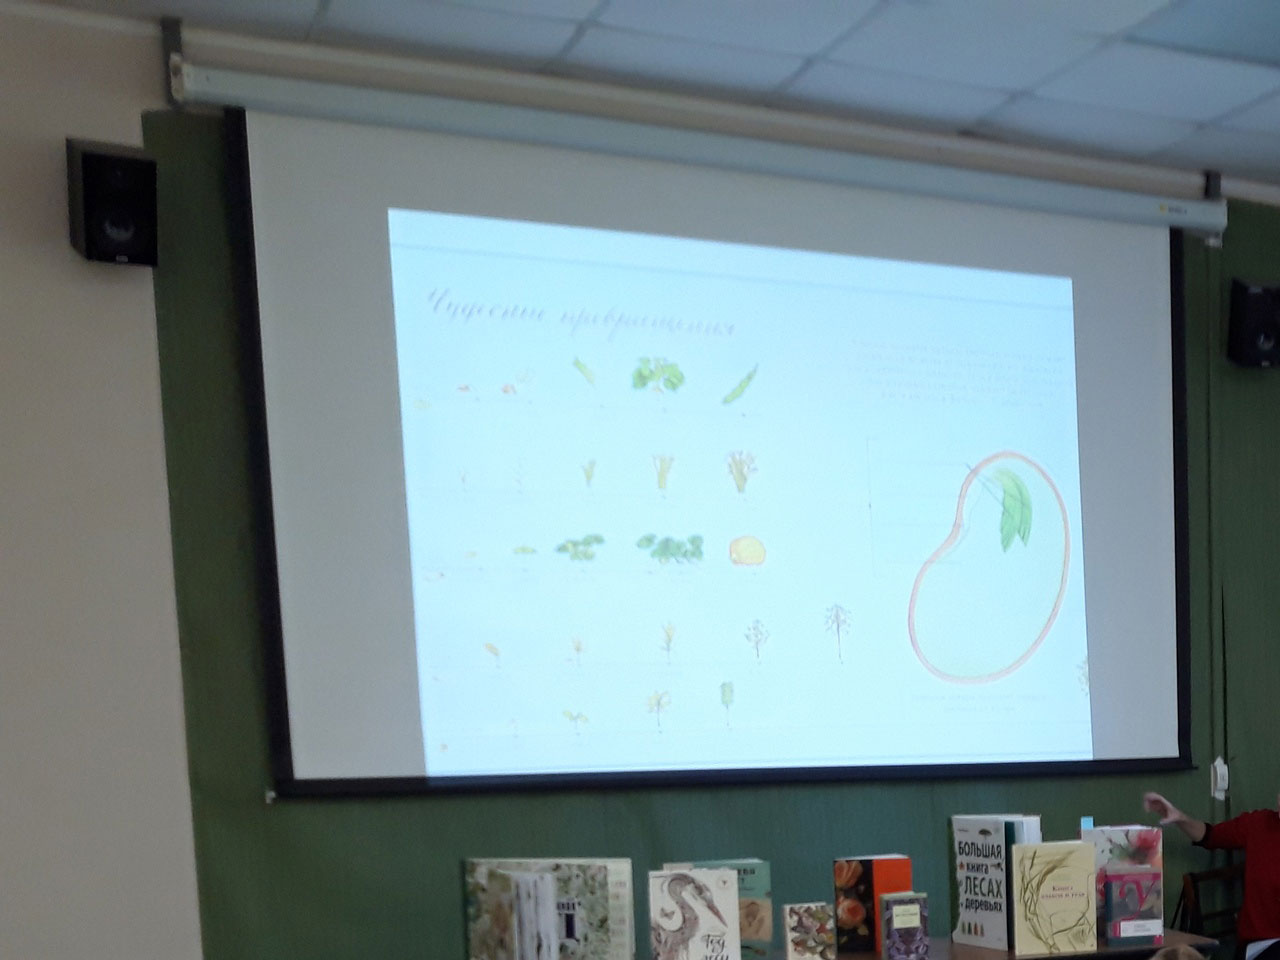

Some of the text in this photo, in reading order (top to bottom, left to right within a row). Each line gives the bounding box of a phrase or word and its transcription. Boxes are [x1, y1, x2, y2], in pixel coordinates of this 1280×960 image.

[958, 842, 1002, 859] БОЛЬШАЯ
[966, 862, 989, 875] книга
[965, 876, 1003, 899] ЛЕСАХ
[965, 898, 1002, 913] деревьях
